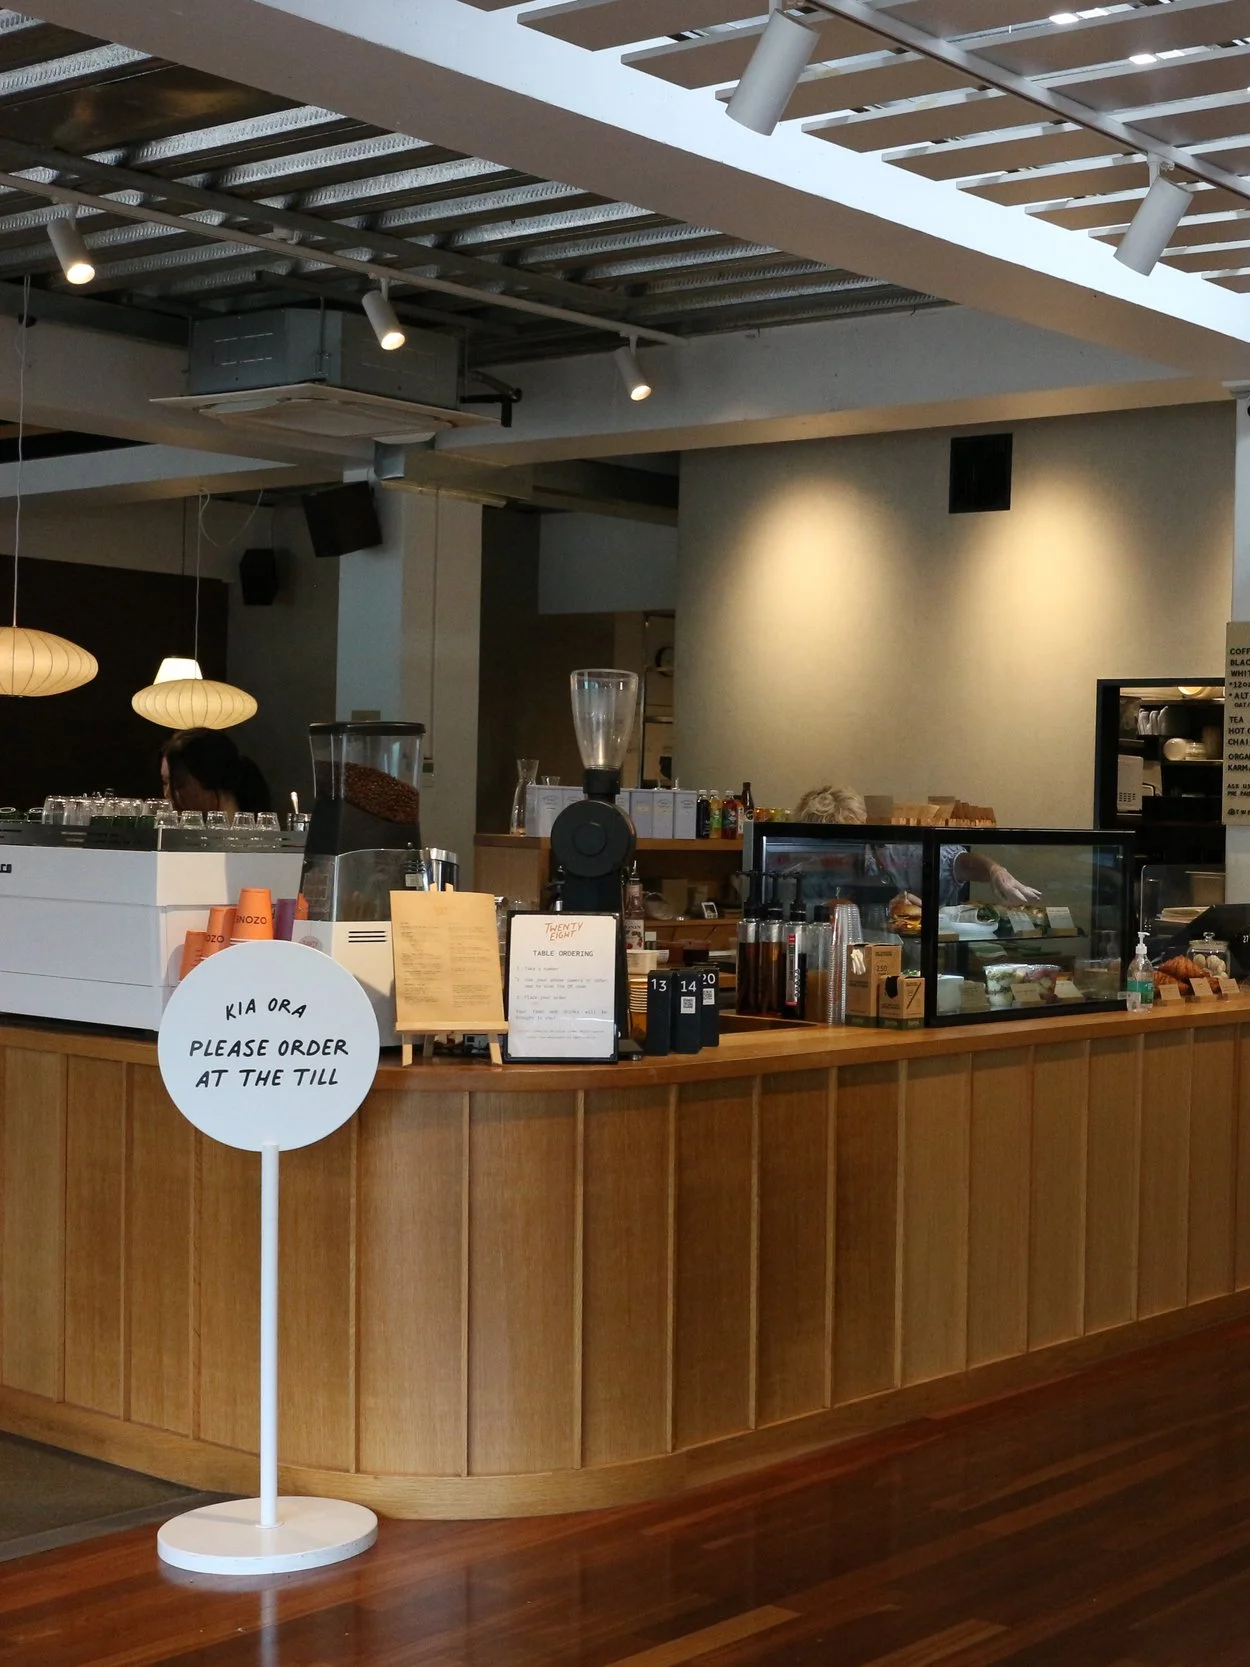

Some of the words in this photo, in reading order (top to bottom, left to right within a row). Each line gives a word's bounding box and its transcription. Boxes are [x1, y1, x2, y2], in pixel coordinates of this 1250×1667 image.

[544, 922, 584, 933] TWENTY
[550, 930, 577, 941] EIGHT
[1242, 935, 1249, 943] 27
[651, 978, 667, 992] 13
[680, 980, 696, 992] 14
[225, 998, 256, 1021] KIA
[268, 998, 307, 1018] ORA
[189, 1039, 270, 1058] PLEASE
[278, 1038, 349, 1056] ORDER
[195, 1069, 228, 1088] AT
[238, 1069, 284, 1087] THE
[293, 1068, 338, 1086] TILL
